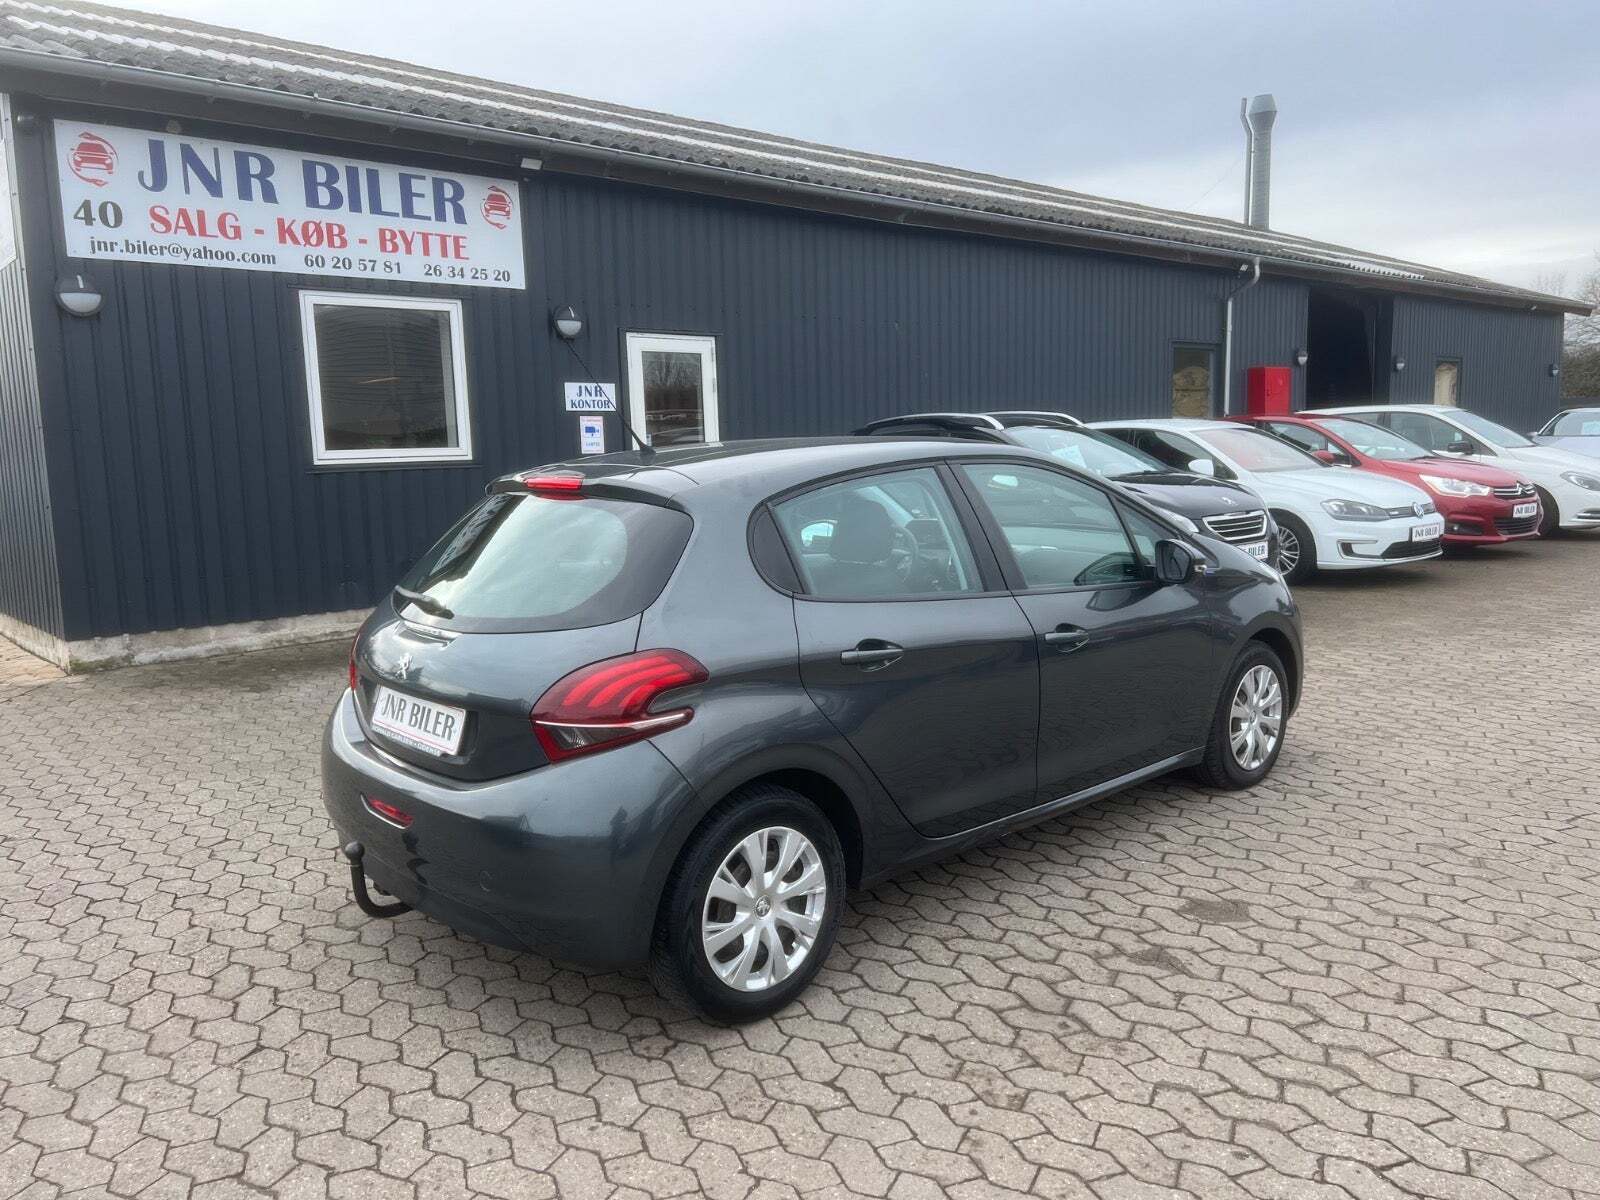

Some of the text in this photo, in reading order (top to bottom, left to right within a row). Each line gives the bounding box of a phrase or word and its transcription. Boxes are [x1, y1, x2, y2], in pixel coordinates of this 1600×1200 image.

[137, 138, 467, 225] JNR BILER
[73, 199, 123, 229] 40
[148, 205, 242, 240] SALG
[277, 216, 347, 249] KØB
[378, 228, 470, 260] BYTTE
[90, 236, 277, 265] jnr.biler@yahoo.com
[304, 254, 401, 274] 60 20 57 81
[423, 263, 511, 282] 26 34 25 20
[571, 399, 610, 409] KONTOR
[577, 385, 603, 397] JNR
[382, 693, 455, 741] JNR BILER
